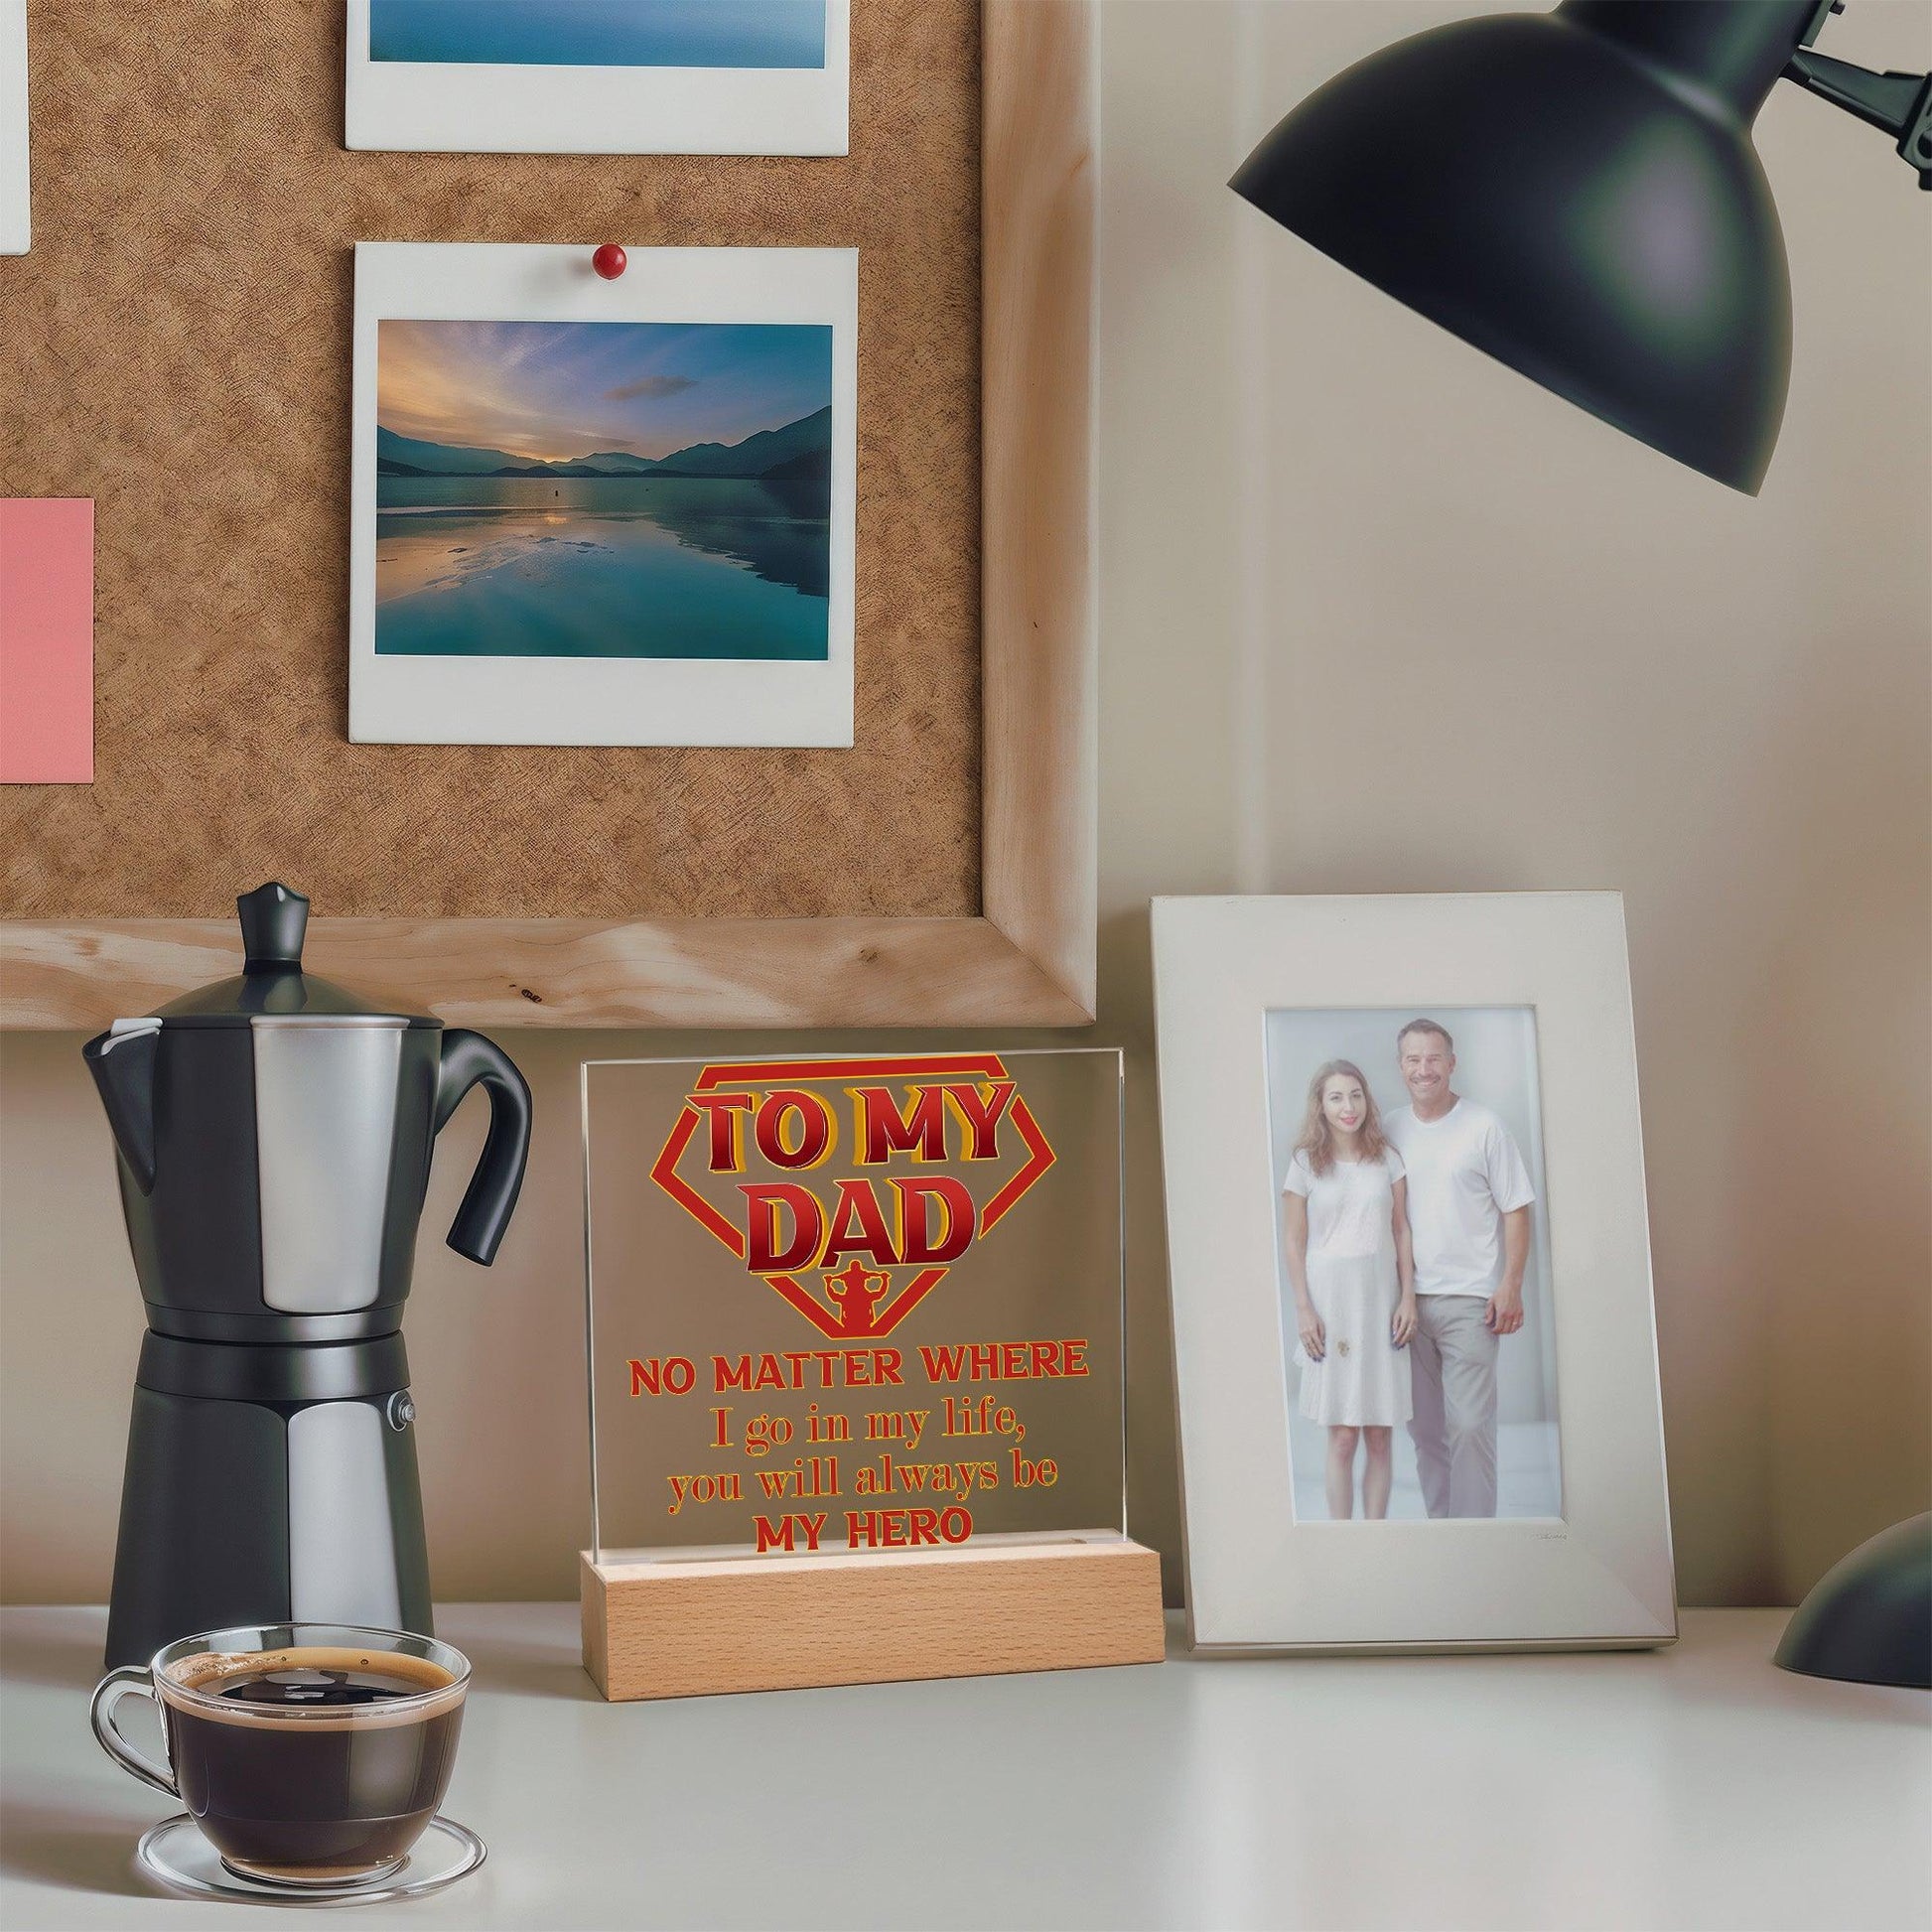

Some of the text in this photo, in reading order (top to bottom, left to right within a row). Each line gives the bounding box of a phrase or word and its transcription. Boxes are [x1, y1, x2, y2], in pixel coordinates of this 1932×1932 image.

[686, 1081, 1017, 1173] TO MY
[736, 1175, 978, 1275] DAD
[626, 1338, 1090, 1397] NO MATTER WHERE
[709, 1394, 1028, 1456] I go in my life,
[666, 1448, 1059, 1515] you will always be
[752, 1505, 974, 1554] MY HERO
